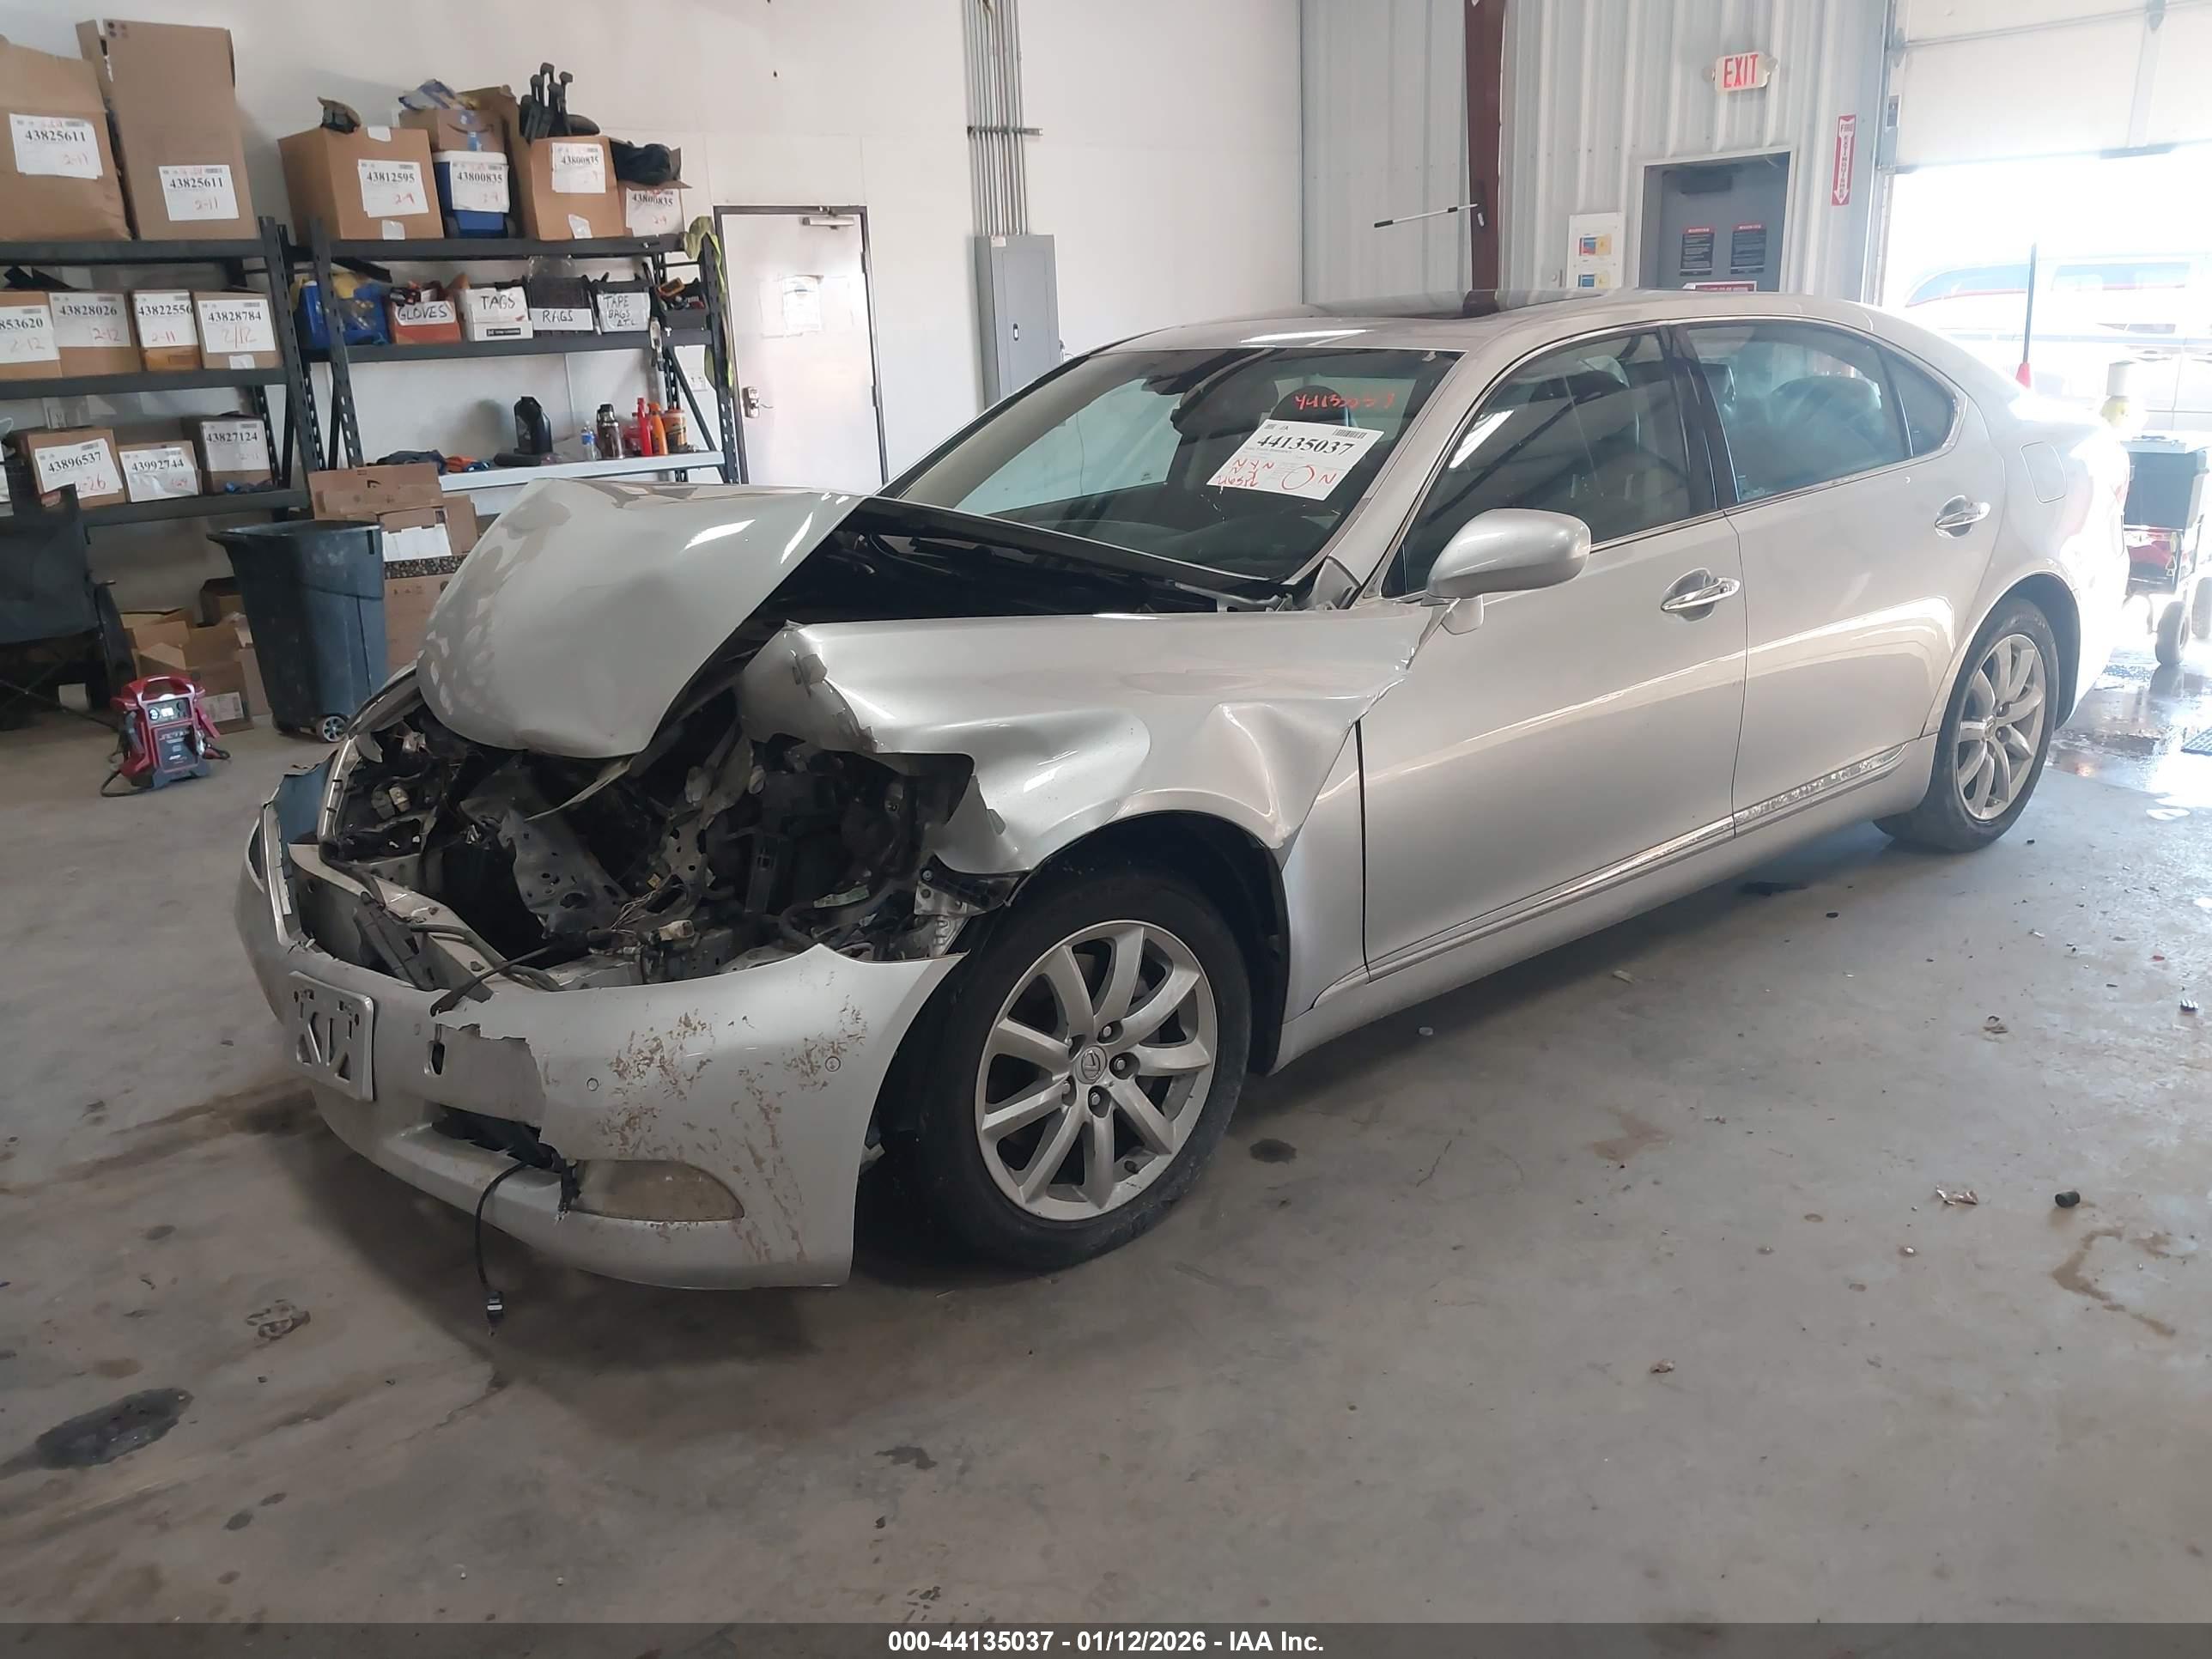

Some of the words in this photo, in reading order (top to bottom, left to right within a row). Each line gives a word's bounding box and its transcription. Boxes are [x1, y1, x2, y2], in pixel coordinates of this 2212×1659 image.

[1724, 54, 1759, 88] EXIT
[25, 130, 86, 142] 43825611
[561, 155, 599, 166] 43800835
[170, 177, 223, 188] 43825611
[367, 171, 416, 183] 43812595
[457, 173, 503, 184] 43800835
[632, 194, 673, 206] 43800835
[481, 295, 515, 309] TAGS
[603, 295, 629, 309] TAPE
[59, 305, 118, 316] 43828026
[209, 310, 261, 322] 43828784
[398, 307, 447, 320] GLOVES
[543, 309, 574, 323] RAGS
[609, 309, 630, 319] BAGS
[206, 432, 258, 442] 43827124
[1257, 434, 1356, 456] 44135037
[48, 452, 101, 472] 43896537
[131, 458, 185, 471] 43992744
